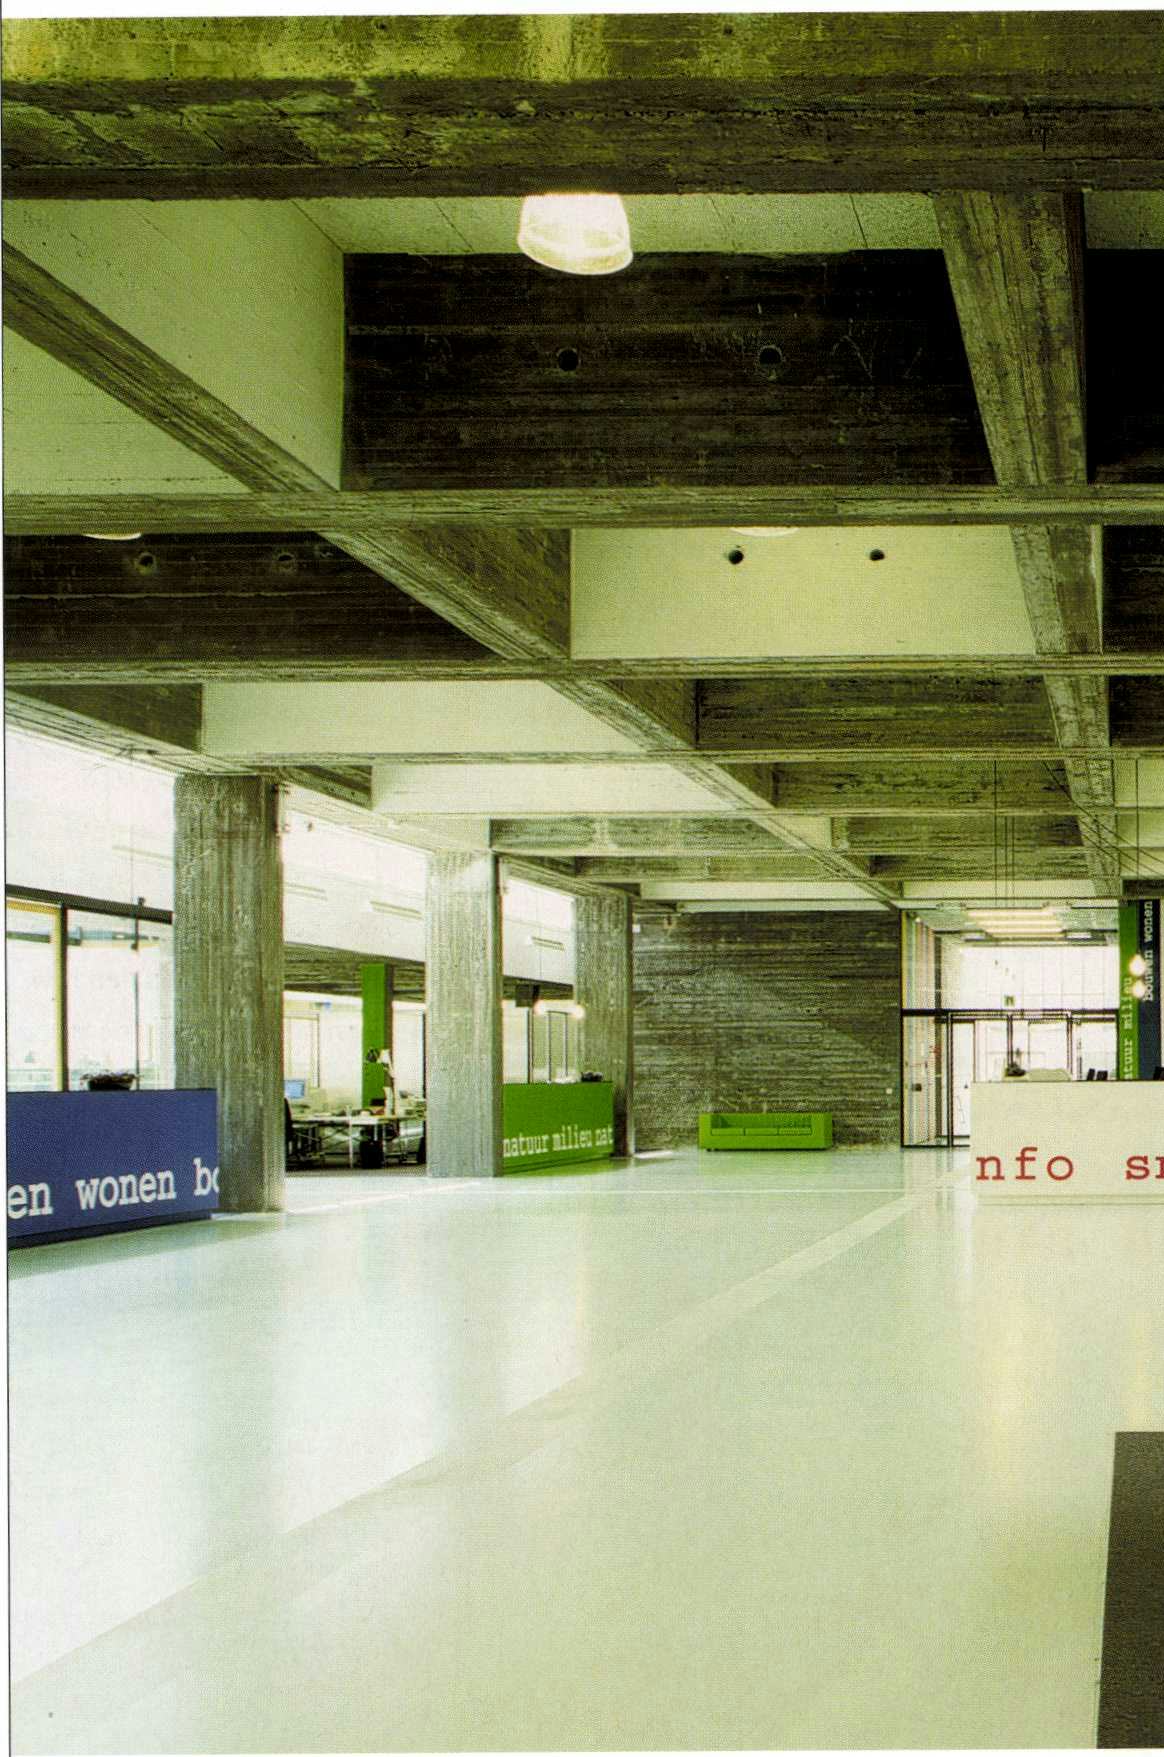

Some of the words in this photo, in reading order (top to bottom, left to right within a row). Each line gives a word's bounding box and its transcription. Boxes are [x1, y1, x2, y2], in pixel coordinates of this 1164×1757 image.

[1144, 901, 1153, 943] wonen
[504, 1132, 549, 1158] natuur
[975, 1146, 1074, 1181] nfo
[7, 1182, 53, 1219] en
[75, 1169, 177, 1211] wonen
